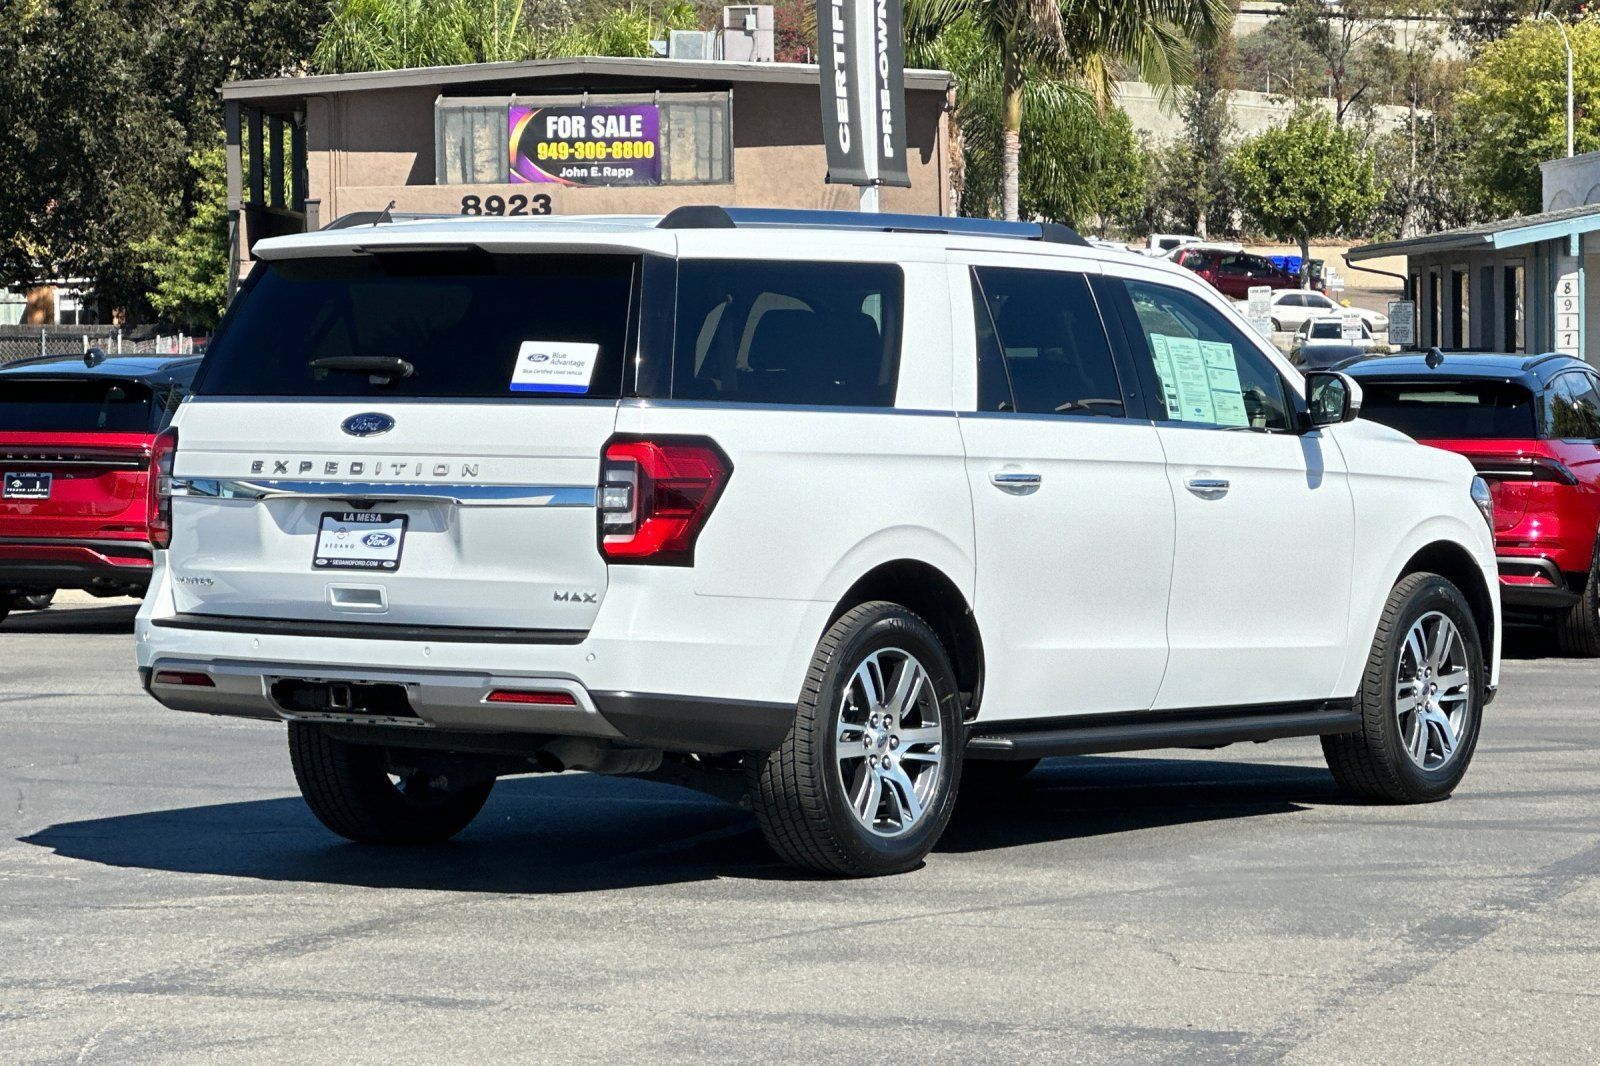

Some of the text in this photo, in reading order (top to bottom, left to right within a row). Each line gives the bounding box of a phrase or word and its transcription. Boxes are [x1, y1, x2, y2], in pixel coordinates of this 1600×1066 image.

[877, 0, 894, 158] PRE-OWN
[546, 115, 643, 139] FOR SALE
[537, 141, 655, 160] 949-306-8800
[559, 167, 634, 179] John E. Rapp
[461, 194, 552, 216] 8923
[549, 359, 586, 368] Advantage
[350, 417, 383, 432] Ford
[250, 460, 479, 477] EXPEDITION
[343, 513, 382, 522] LA MESA
[366, 534, 390, 547] Ford
[553, 590, 597, 603] MAX
